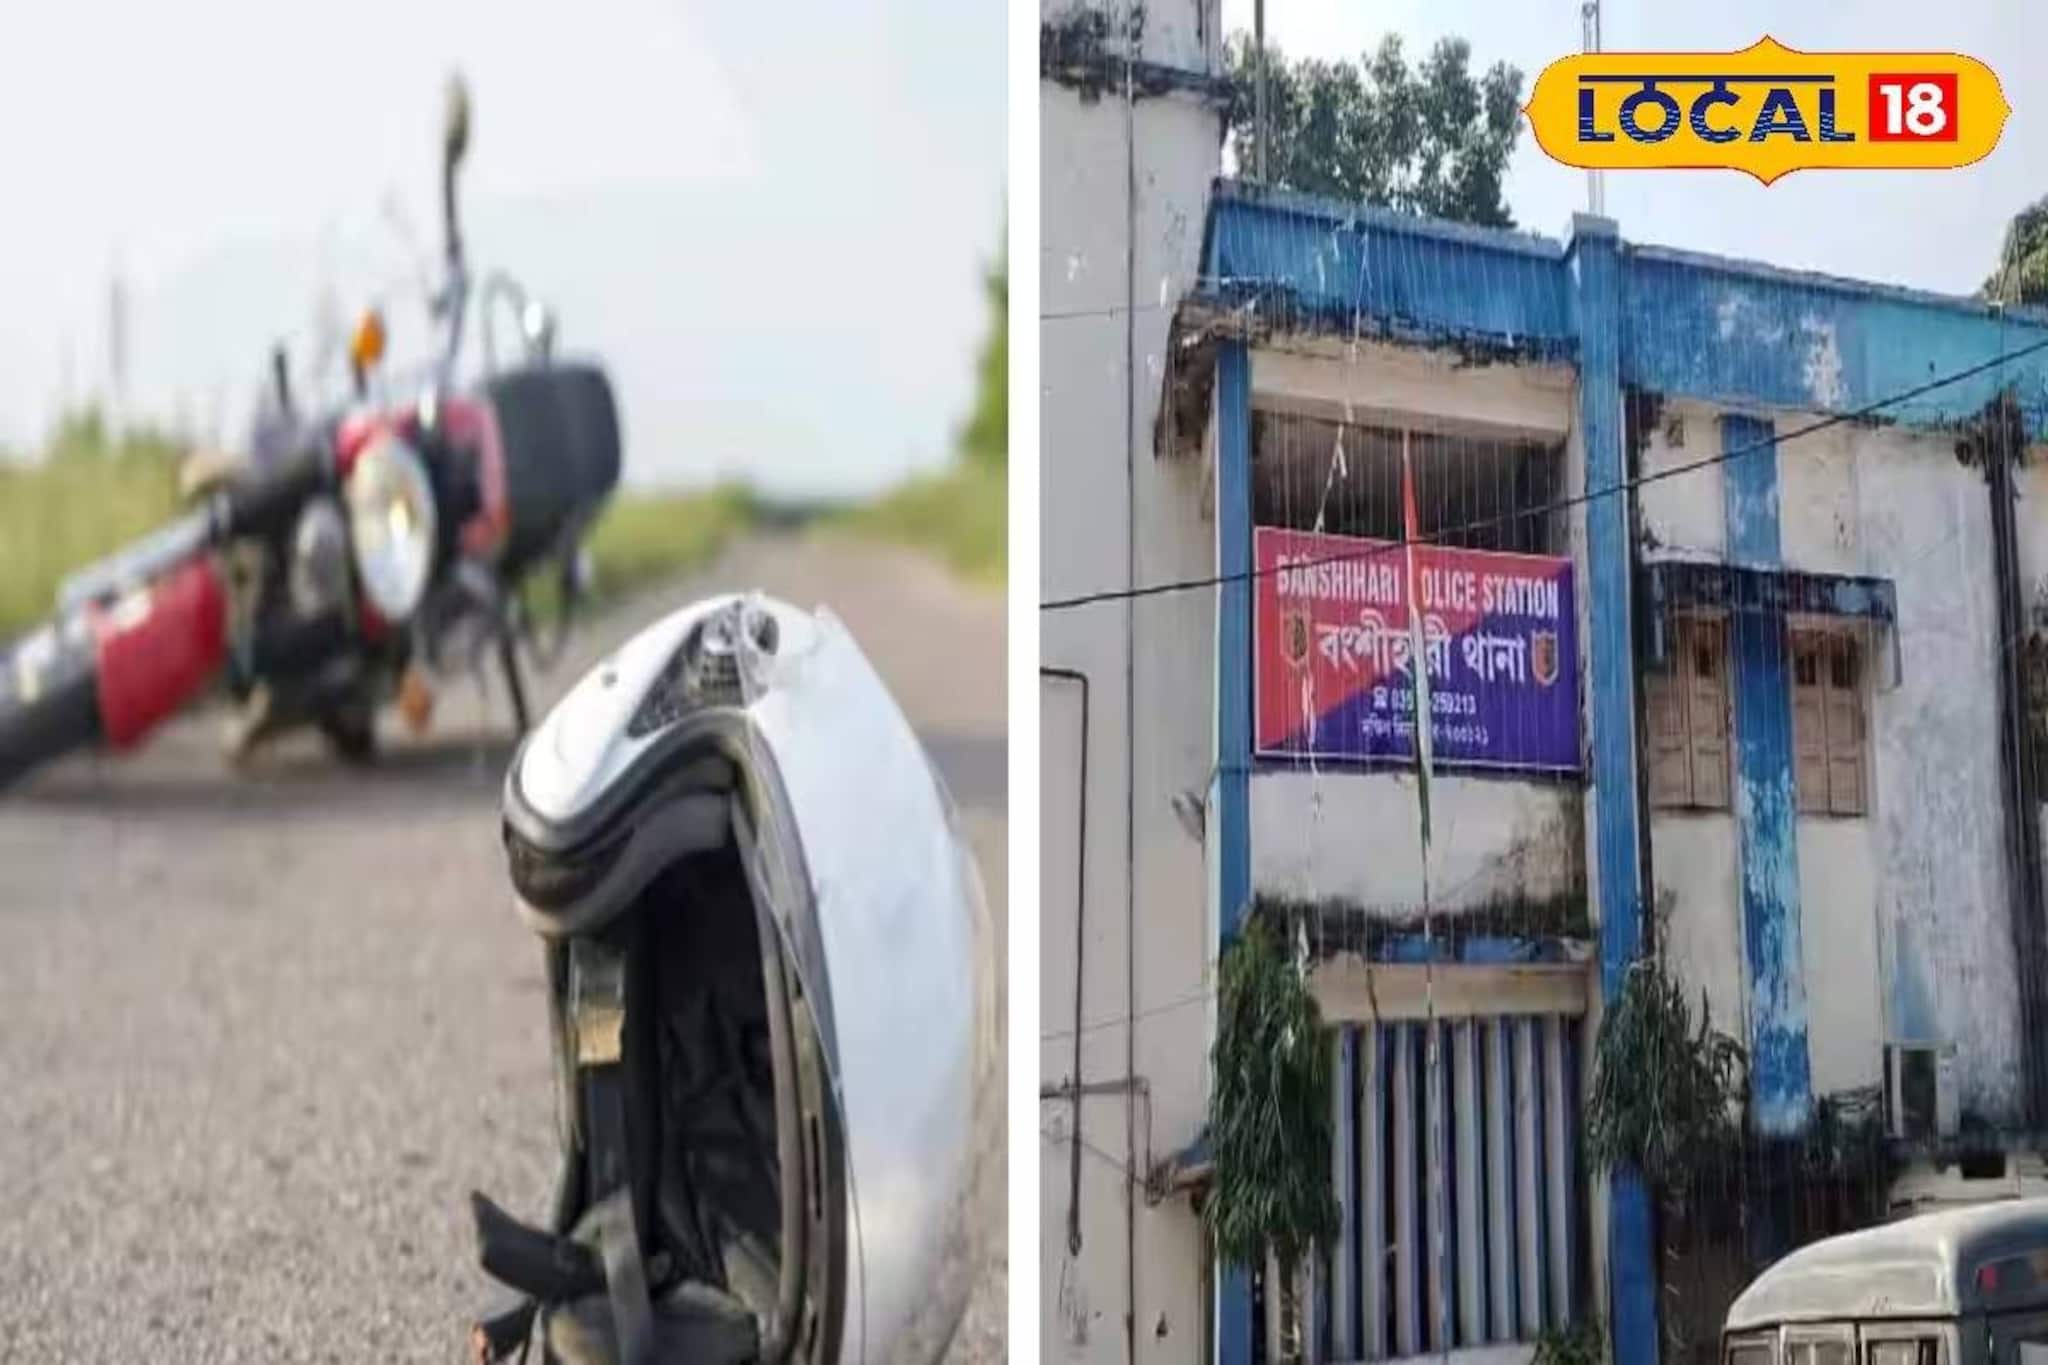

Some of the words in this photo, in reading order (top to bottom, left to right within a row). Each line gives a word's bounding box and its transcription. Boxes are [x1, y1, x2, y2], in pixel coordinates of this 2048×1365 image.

[1277, 553, 1400, 605] BANSHIHARI
[1409, 566, 1477, 612] OLICE
[1482, 573, 1559, 618] STATION
[1315, 608, 1451, 680] বংশীহরী
[1462, 631, 1526, 684] থানা
